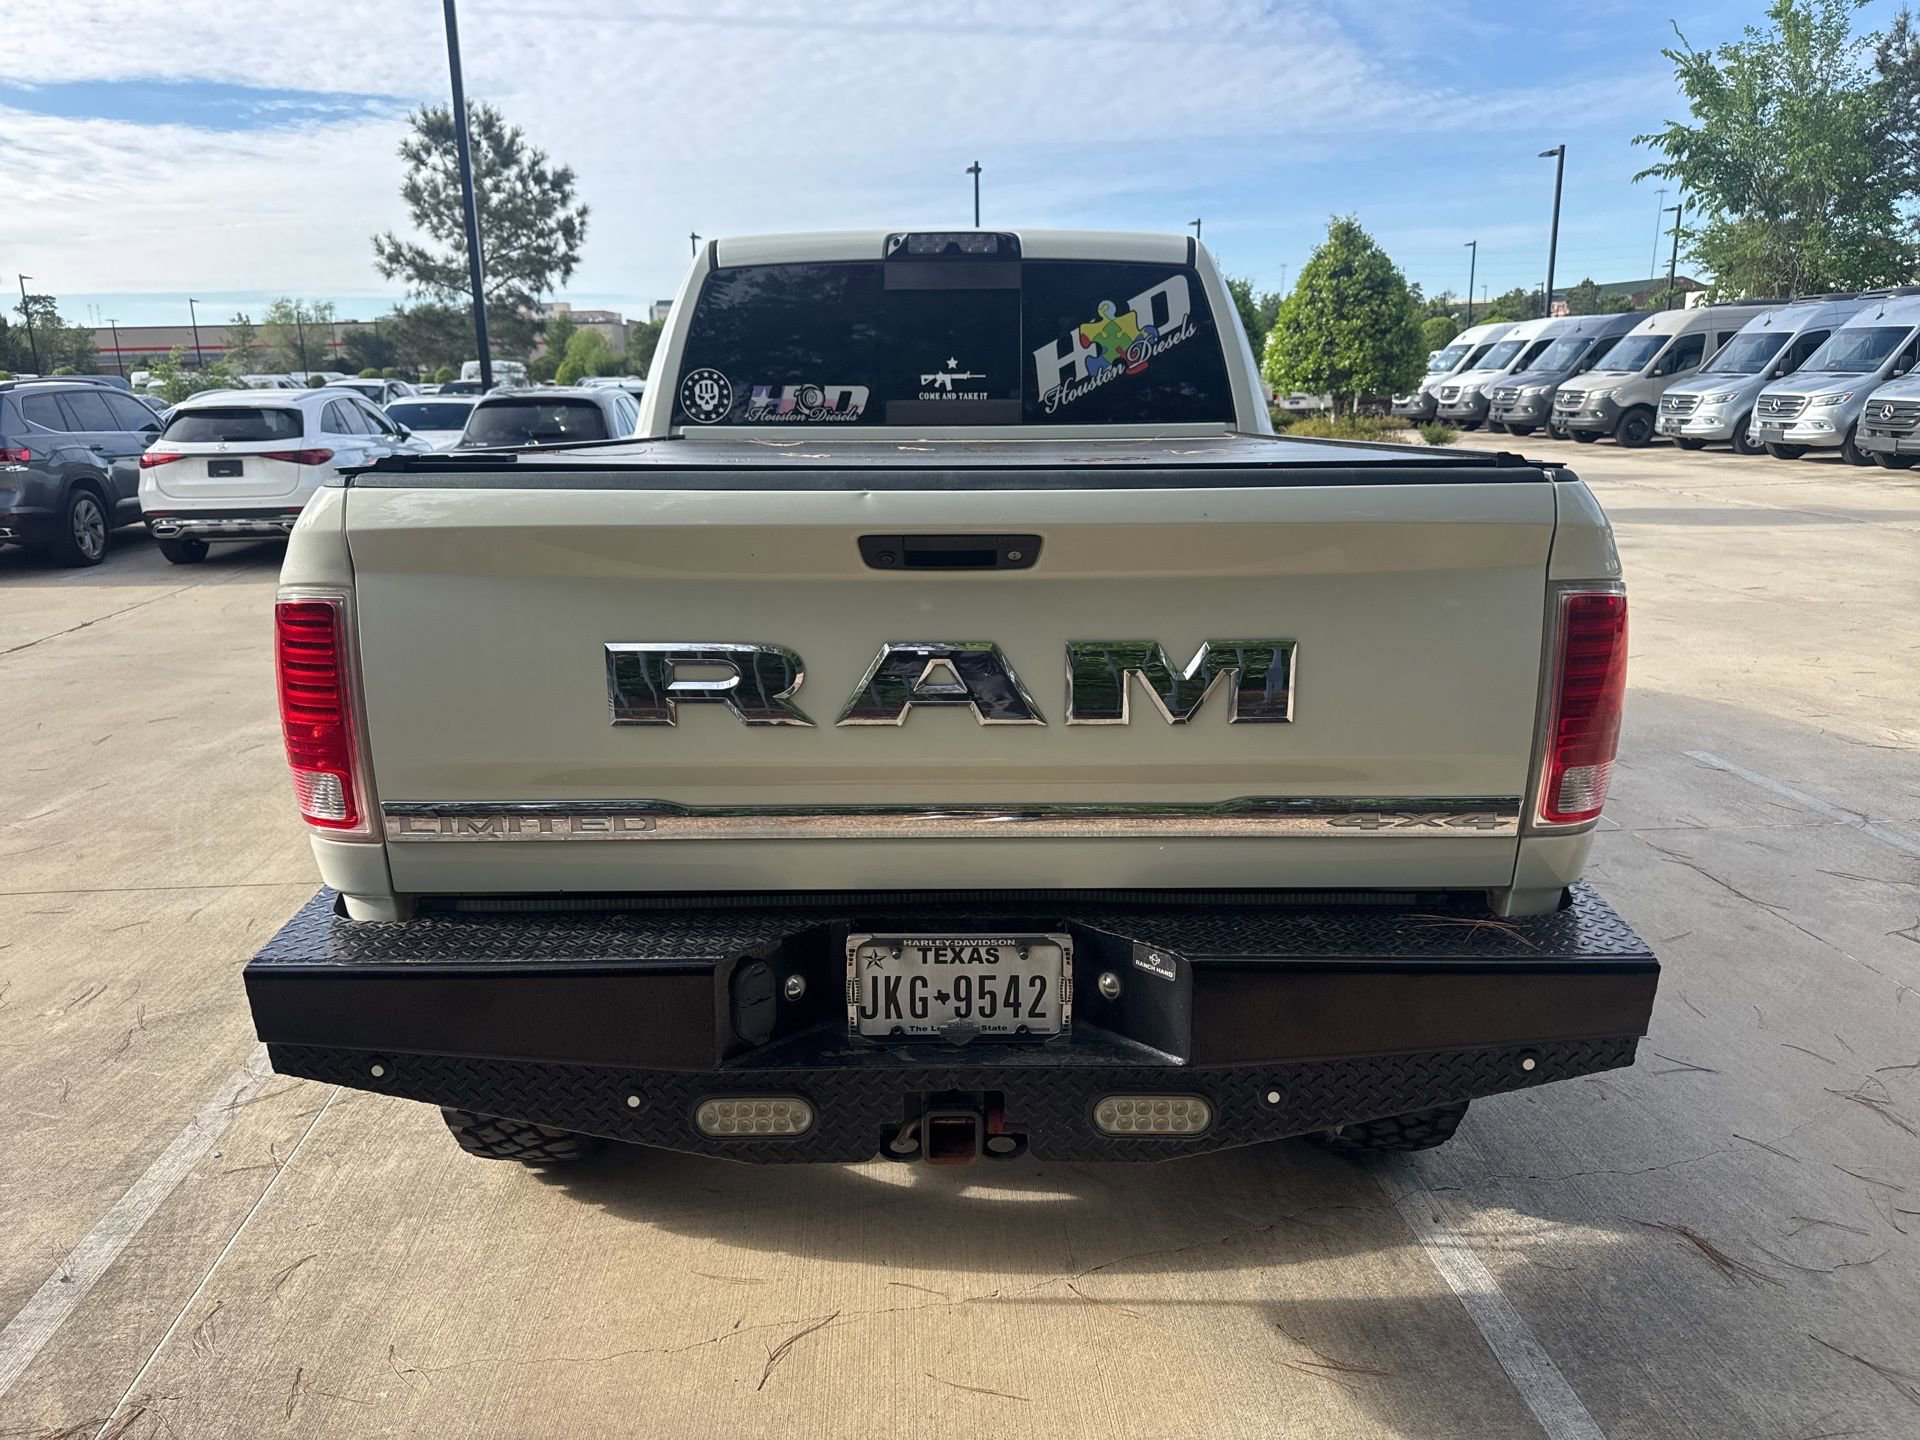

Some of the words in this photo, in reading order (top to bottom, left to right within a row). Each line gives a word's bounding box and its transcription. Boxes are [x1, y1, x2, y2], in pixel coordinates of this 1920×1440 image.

[1044, 361, 1126, 414] Houston
[1126, 312, 1197, 370] Diesels
[918, 392, 941, 401] COME
[942, 392, 957, 401] AND
[958, 392, 979, 401] TAKE
[980, 392, 988, 401] IT
[748, 405, 807, 422] Houston
[807, 404, 859, 422] Diesels
[604, 640, 1298, 727] RAM
[398, 815, 657, 837] LIMITED
[903, 939, 1016, 947] HARLEY-DAVIDSON
[917, 947, 1000, 965] TEXAS
[1135, 959, 1156, 972] RANCH
[1156, 967, 1173, 978] HAND
[981, 1024, 1008, 1032] State
